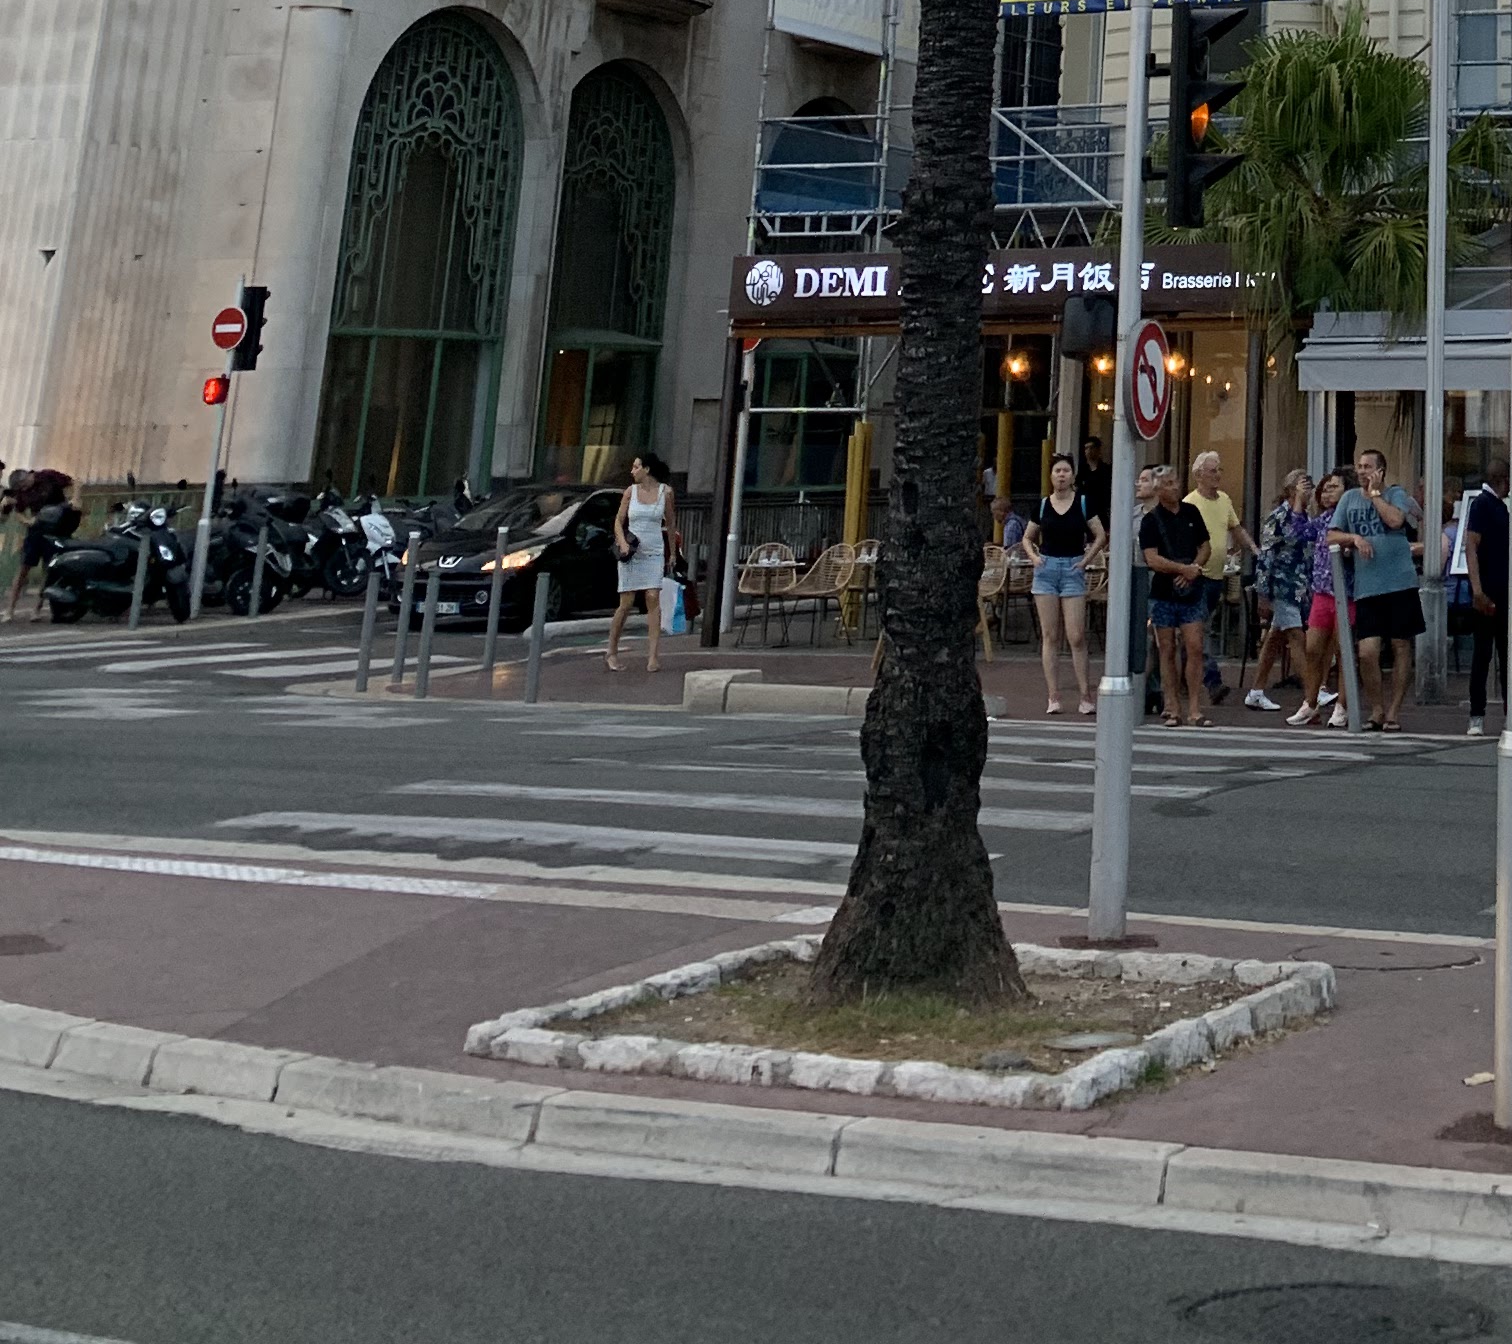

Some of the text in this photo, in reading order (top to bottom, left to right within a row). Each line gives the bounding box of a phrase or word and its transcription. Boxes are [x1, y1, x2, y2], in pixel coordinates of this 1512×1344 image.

[793, 265, 889, 298] DEMI
[1162, 272, 1232, 289] Brasserie
[1350, 507, 1378, 523] TRU
